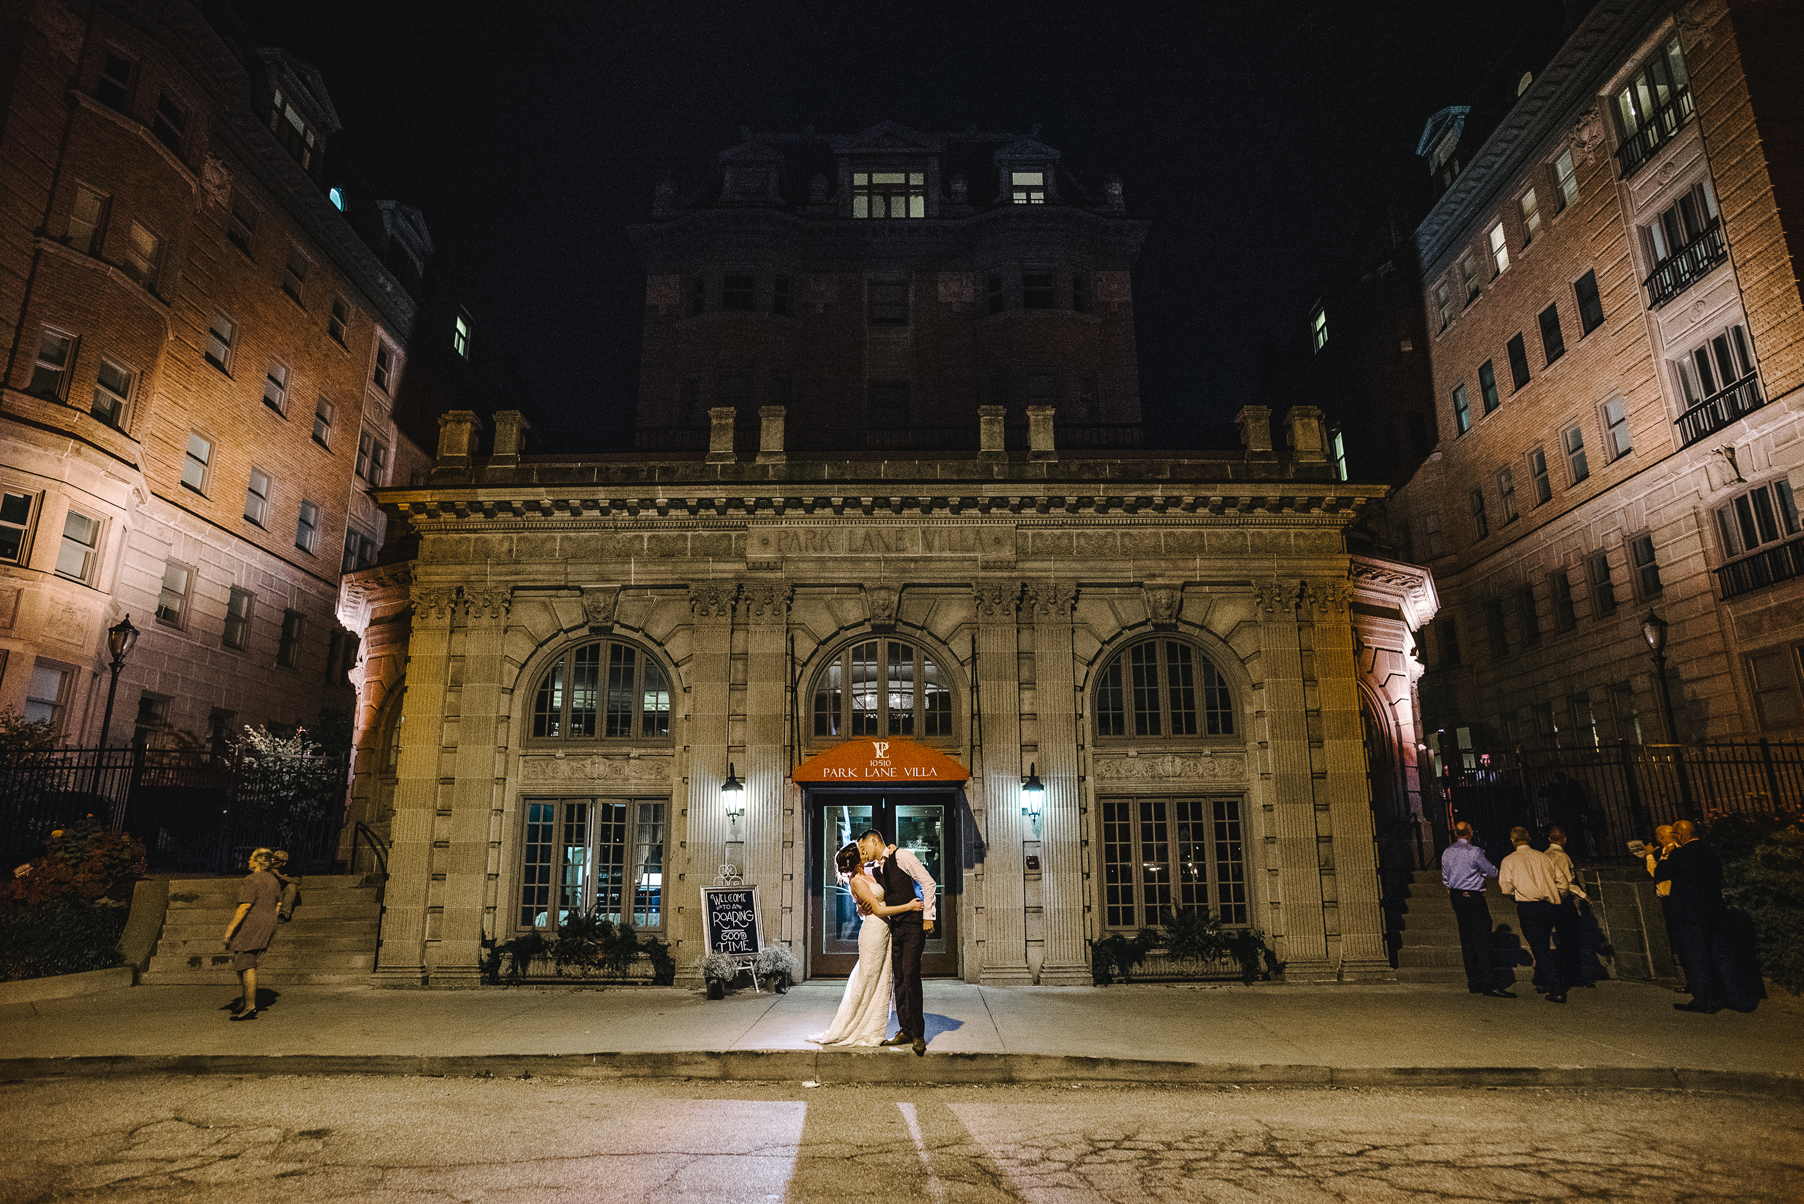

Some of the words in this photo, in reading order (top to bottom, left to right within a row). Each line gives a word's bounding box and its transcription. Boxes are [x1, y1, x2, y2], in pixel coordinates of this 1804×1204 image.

[777, 530, 833, 552] PARK
[849, 530, 906, 552] LANE
[921, 529, 985, 552] VILLA
[823, 767, 858, 778] PARK
[864, 767, 898, 778] LANE
[903, 766, 938, 777] VILLA
[710, 893, 746, 905] WELCOME
[713, 910, 754, 929] ROARING
[721, 931, 747, 940] GOOD
[716, 940, 753, 952] TIME
